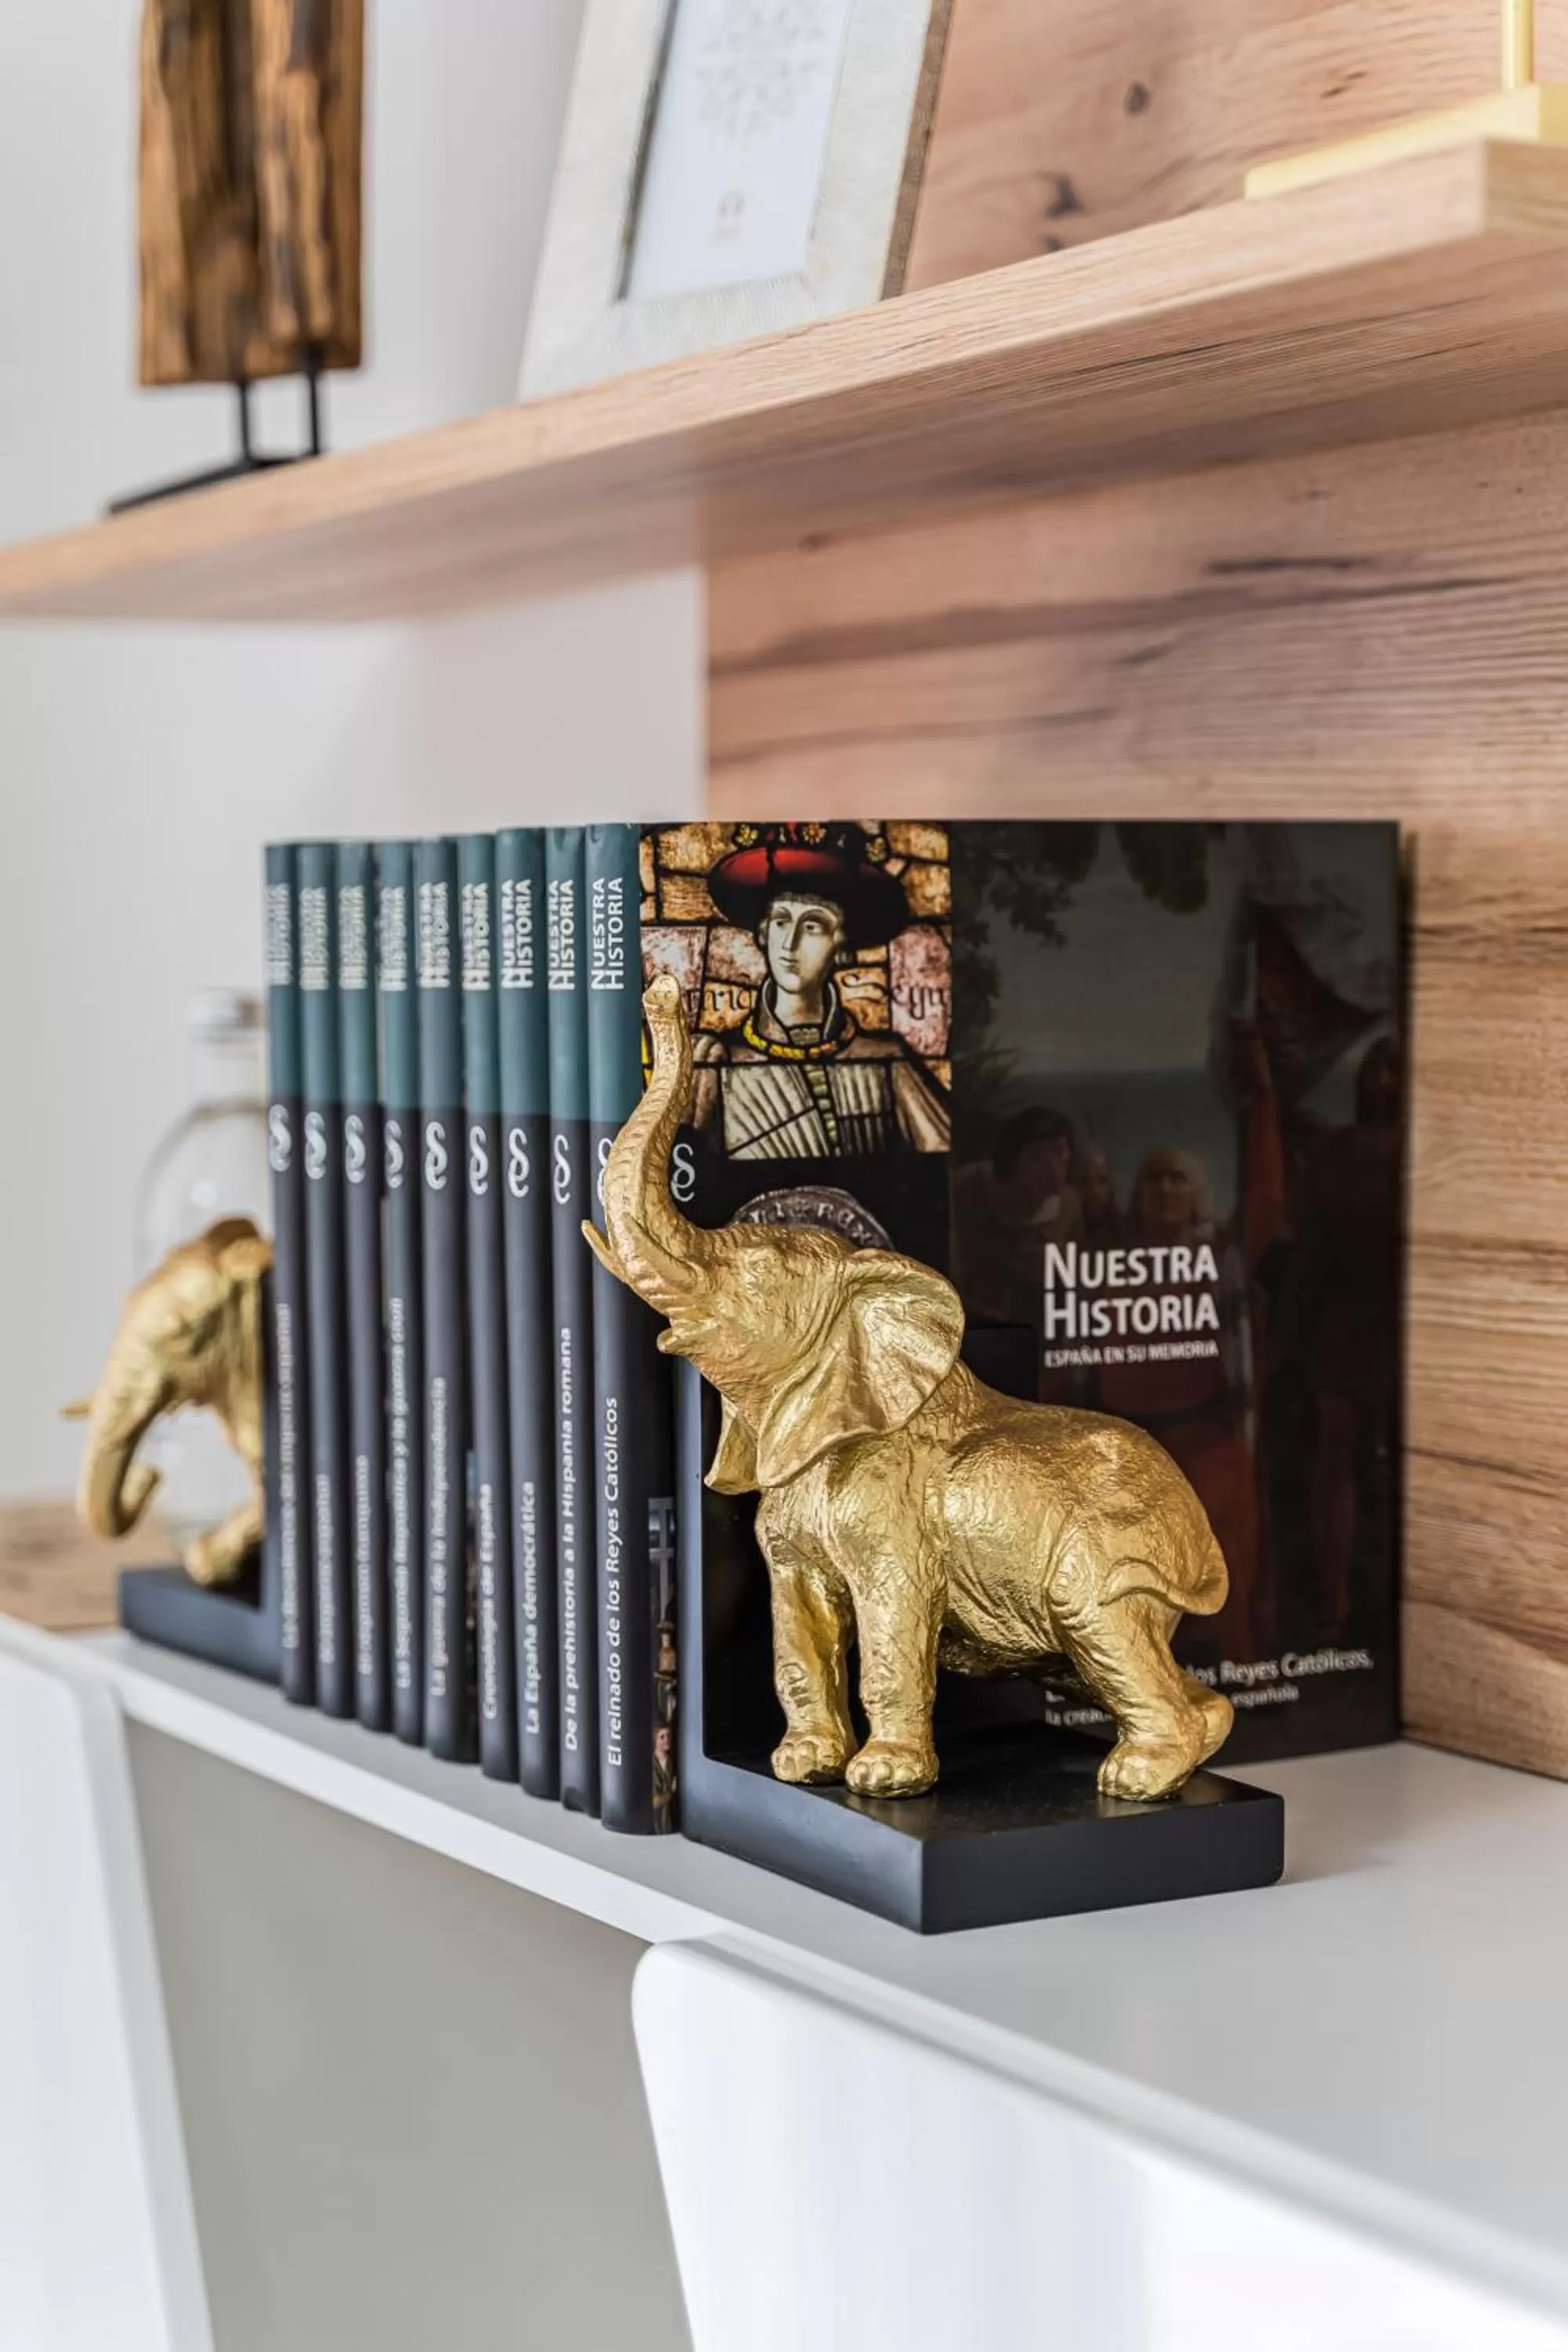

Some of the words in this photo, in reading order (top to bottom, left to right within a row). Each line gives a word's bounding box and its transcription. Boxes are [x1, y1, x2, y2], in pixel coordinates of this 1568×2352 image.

[501, 879, 515, 989] NUESTRA
[514, 879, 534, 989] HISTORIA
[548, 879, 560, 991] NUESTRA
[559, 879, 575, 991] HISTORIA
[591, 877, 605, 990] NUESTRA
[605, 877, 625, 990] HISTORIA
[1044, 1241, 1218, 1290] NUESTRA
[1044, 1290, 1220, 1341] HISTORIA
[561, 1327, 572, 1414] romana
[1044, 1345, 1102, 1368] ESPAÑA
[1103, 1345, 1124, 1365] EN
[1126, 1344, 1147, 1363] SU
[1148, 1340, 1218, 1362] MEMORIA
[561, 1421, 576, 1517] Hispania
[603, 1397, 619, 1501] Católicos
[521, 1483, 537, 1621] democrática
[561, 1524, 575, 1543] la
[564, 1549, 575, 1563] a
[604, 1508, 623, 1573] Reyes
[481, 1566, 495, 1595] de
[605, 1580, 620, 1612] los
[563, 1568, 579, 1690] prehistoria
[606, 1617, 620, 1647] de
[524, 1625, 541, 1704] España
[607, 1653, 622, 1735] reinado
[1220, 1659, 1279, 1686] Reyes
[526, 1708, 539, 1735] La
[564, 1694, 577, 1715] la
[564, 1719, 577, 1751] De
[607, 1747, 622, 1766] El
